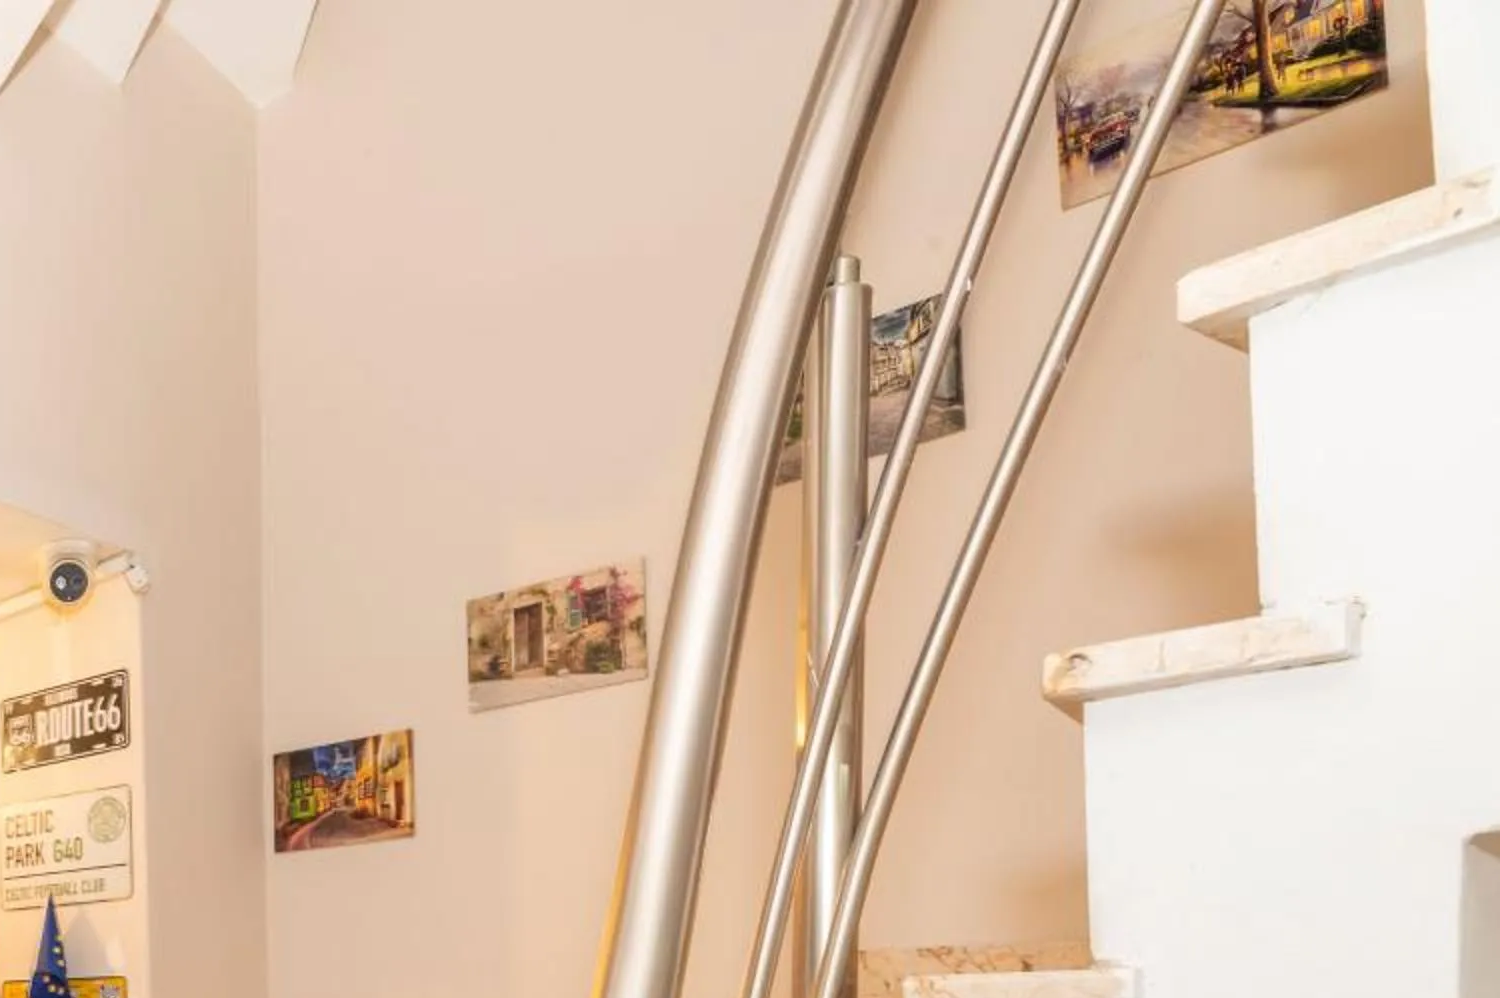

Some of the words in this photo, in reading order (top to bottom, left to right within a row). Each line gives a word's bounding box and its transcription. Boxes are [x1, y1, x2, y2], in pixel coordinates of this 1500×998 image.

[5, 808, 55, 839] CELTIC
[5, 840, 46, 870] PARK
[52, 836, 84, 863] 640
